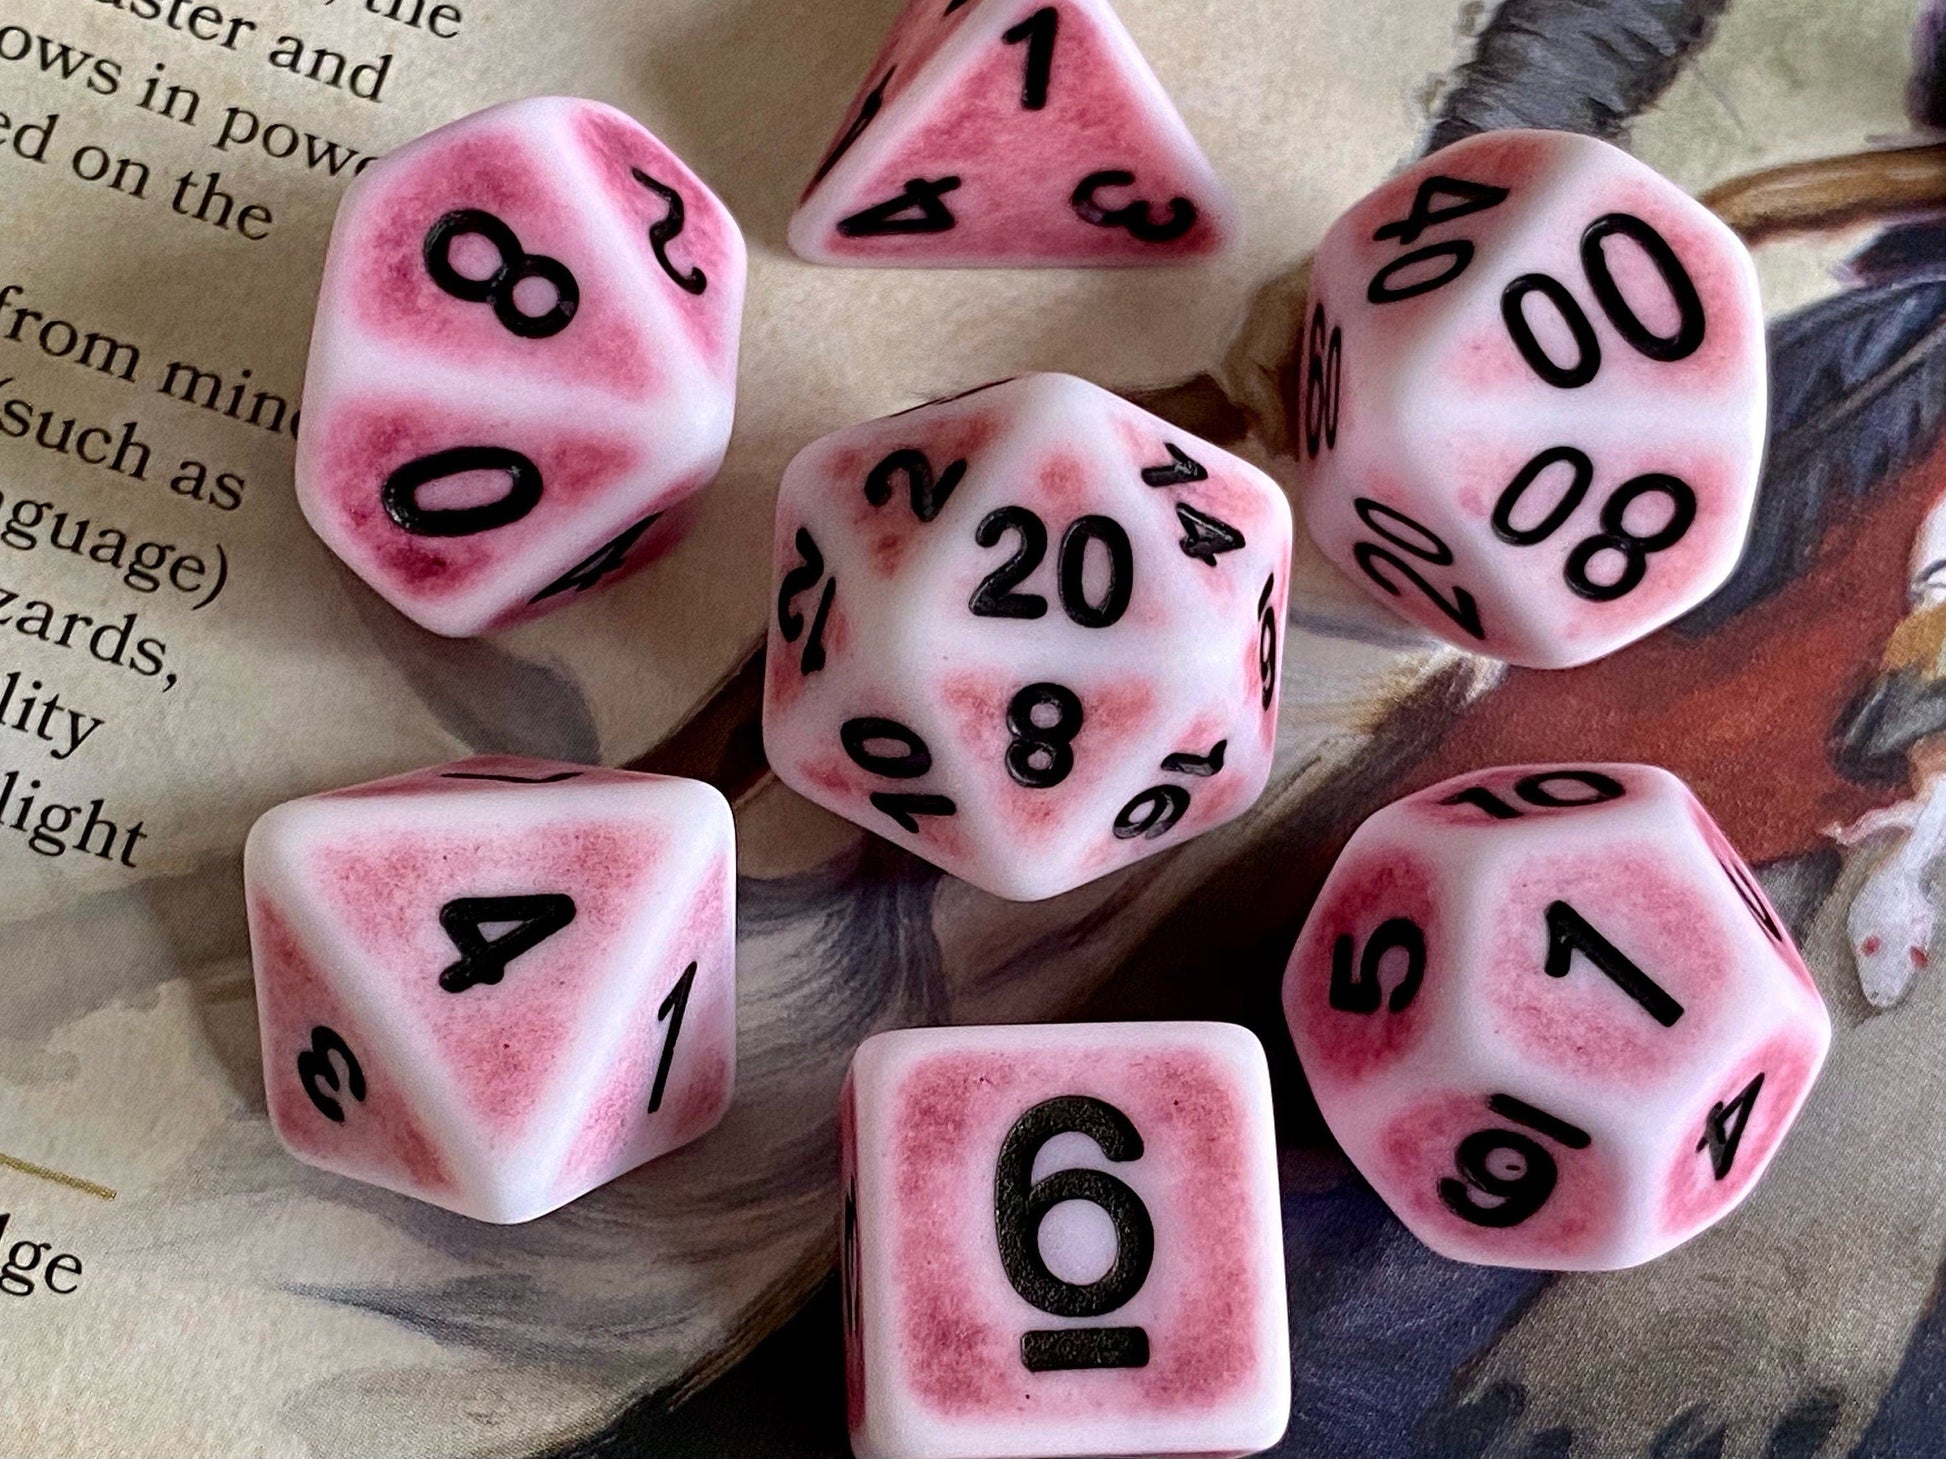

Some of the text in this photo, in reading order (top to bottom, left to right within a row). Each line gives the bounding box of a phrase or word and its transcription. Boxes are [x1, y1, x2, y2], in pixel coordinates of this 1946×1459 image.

[0, 25, 123, 95] ows
[136, 62, 201, 126] in
[95, 0, 393, 102] ster and
[1002, 6, 1058, 110] 1
[72, 144, 151, 200] on
[171, 170, 273, 241] the
[836, 175, 961, 238] 4
[1071, 169, 1198, 245] 3
[1366, 174, 1512, 305] 40
[423, 208, 580, 340] 8
[1501, 212, 1706, 389] 00
[0, 285, 141, 384] from
[170, 459, 246, 512] as
[380, 445, 544, 538] 0
[863, 447, 968, 524] 2
[1140, 442, 1247, 567] 14
[1491, 445, 1698, 603] 80
[0, 491, 229, 611] guage)
[970, 504, 1135, 630] 20
[1352, 496, 1486, 642] 20
[838, 714, 958, 834] 10
[1004, 681, 1085, 789] 8
[1438, 768, 1626, 820] 10
[438, 893, 577, 994] 4
[1328, 916, 1428, 1014] 5
[1544, 900, 1685, 1028] 1
[297, 1025, 367, 1126] 3
[646, 960, 699, 1115] 1
[1696, 1072, 1766, 1181] 4
[994, 1094, 1156, 1373] 6
